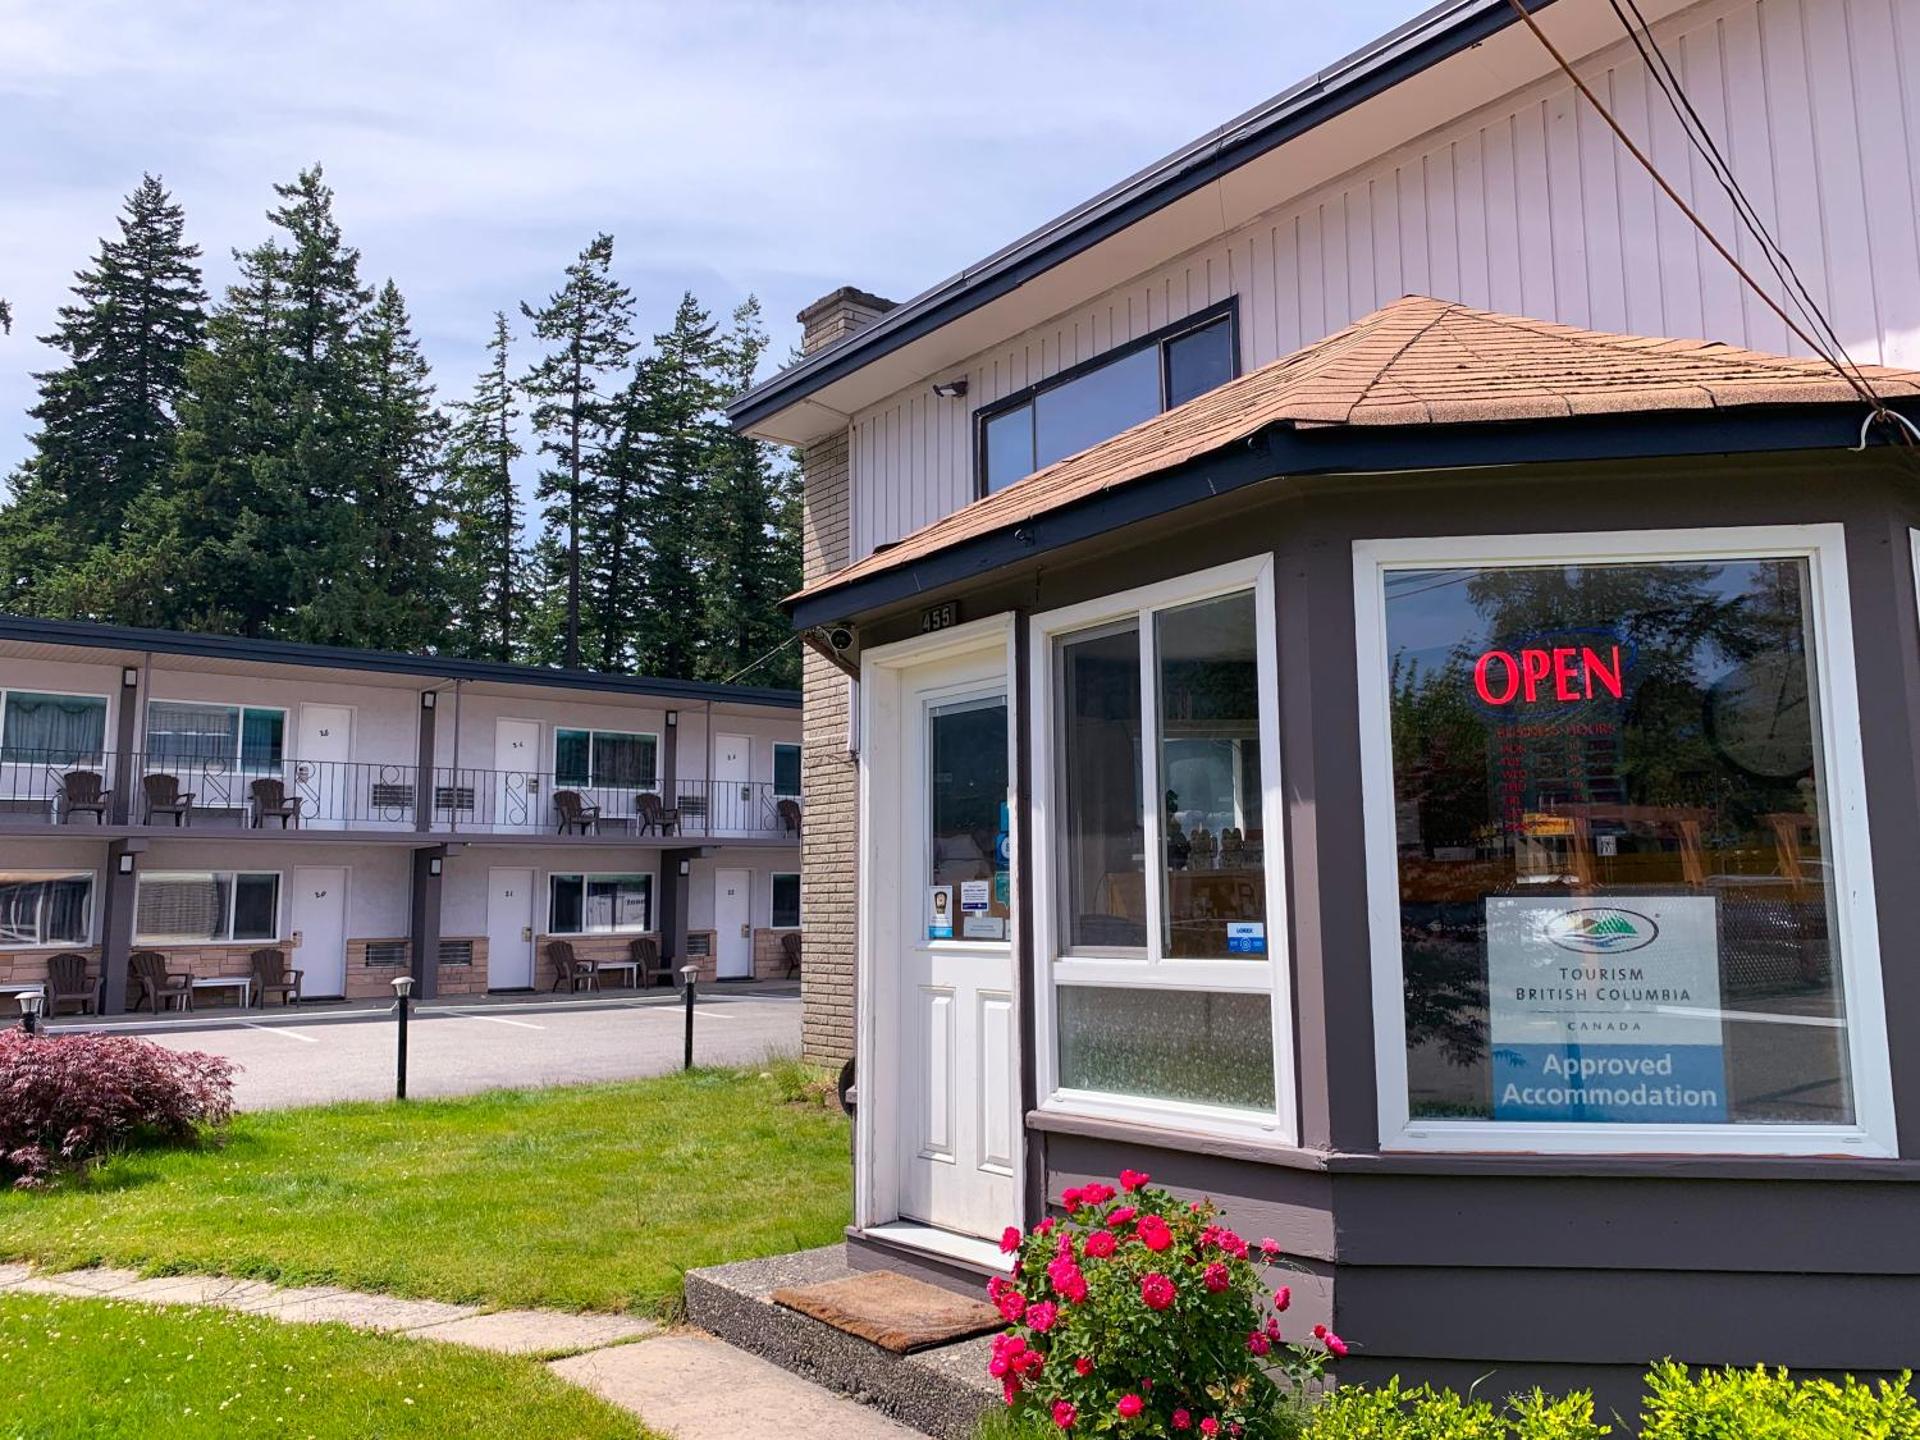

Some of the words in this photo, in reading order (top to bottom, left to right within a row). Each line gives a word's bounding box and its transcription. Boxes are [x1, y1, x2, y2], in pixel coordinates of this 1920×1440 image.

[922, 608, 950, 632] 455
[1474, 645, 1622, 705] OPEN
[1560, 968, 1643, 981] TOURISM
[1516, 988, 1587, 1001] BRITISH
[1597, 988, 1690, 1001] COLUMBIA
[1567, 1022, 1641, 1032] CANADA
[1543, 1053, 1672, 1080] Approved
[1502, 1083, 1718, 1107] Accommodation
